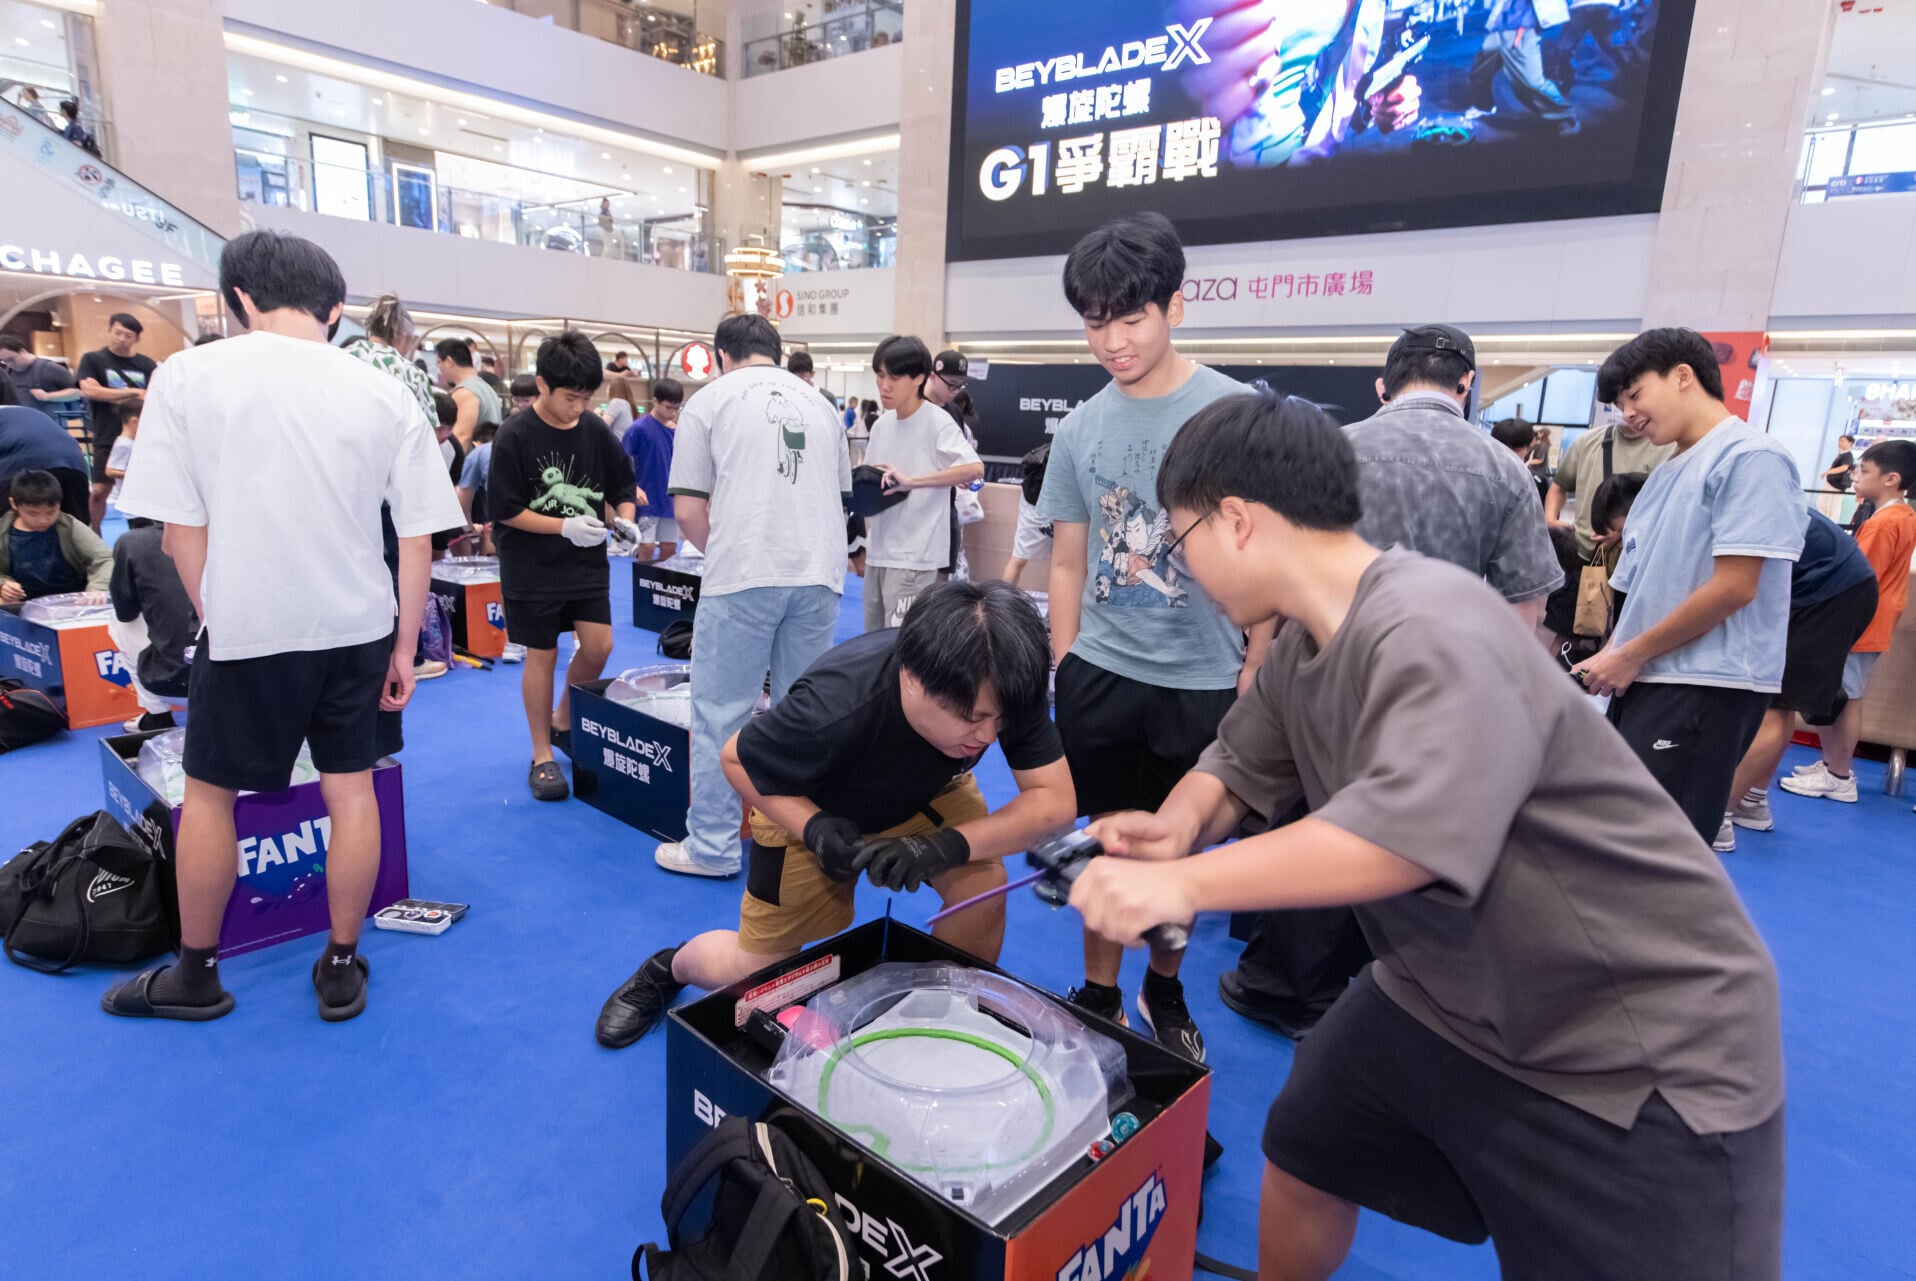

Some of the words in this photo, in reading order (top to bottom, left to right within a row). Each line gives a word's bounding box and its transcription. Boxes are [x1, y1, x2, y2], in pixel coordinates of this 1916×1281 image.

[0, 245, 184, 286] CHAGEE
[796, 290, 817, 301] SINO
[818, 288, 850, 300] GROUP
[1181, 277, 1238, 302] aza
[1248, 270, 1374, 299] 屯門市廣場
[542, 499, 558, 512] AIR
[603, 747, 651, 785] 爆旋陀螺
[237, 815, 332, 878] FANT
